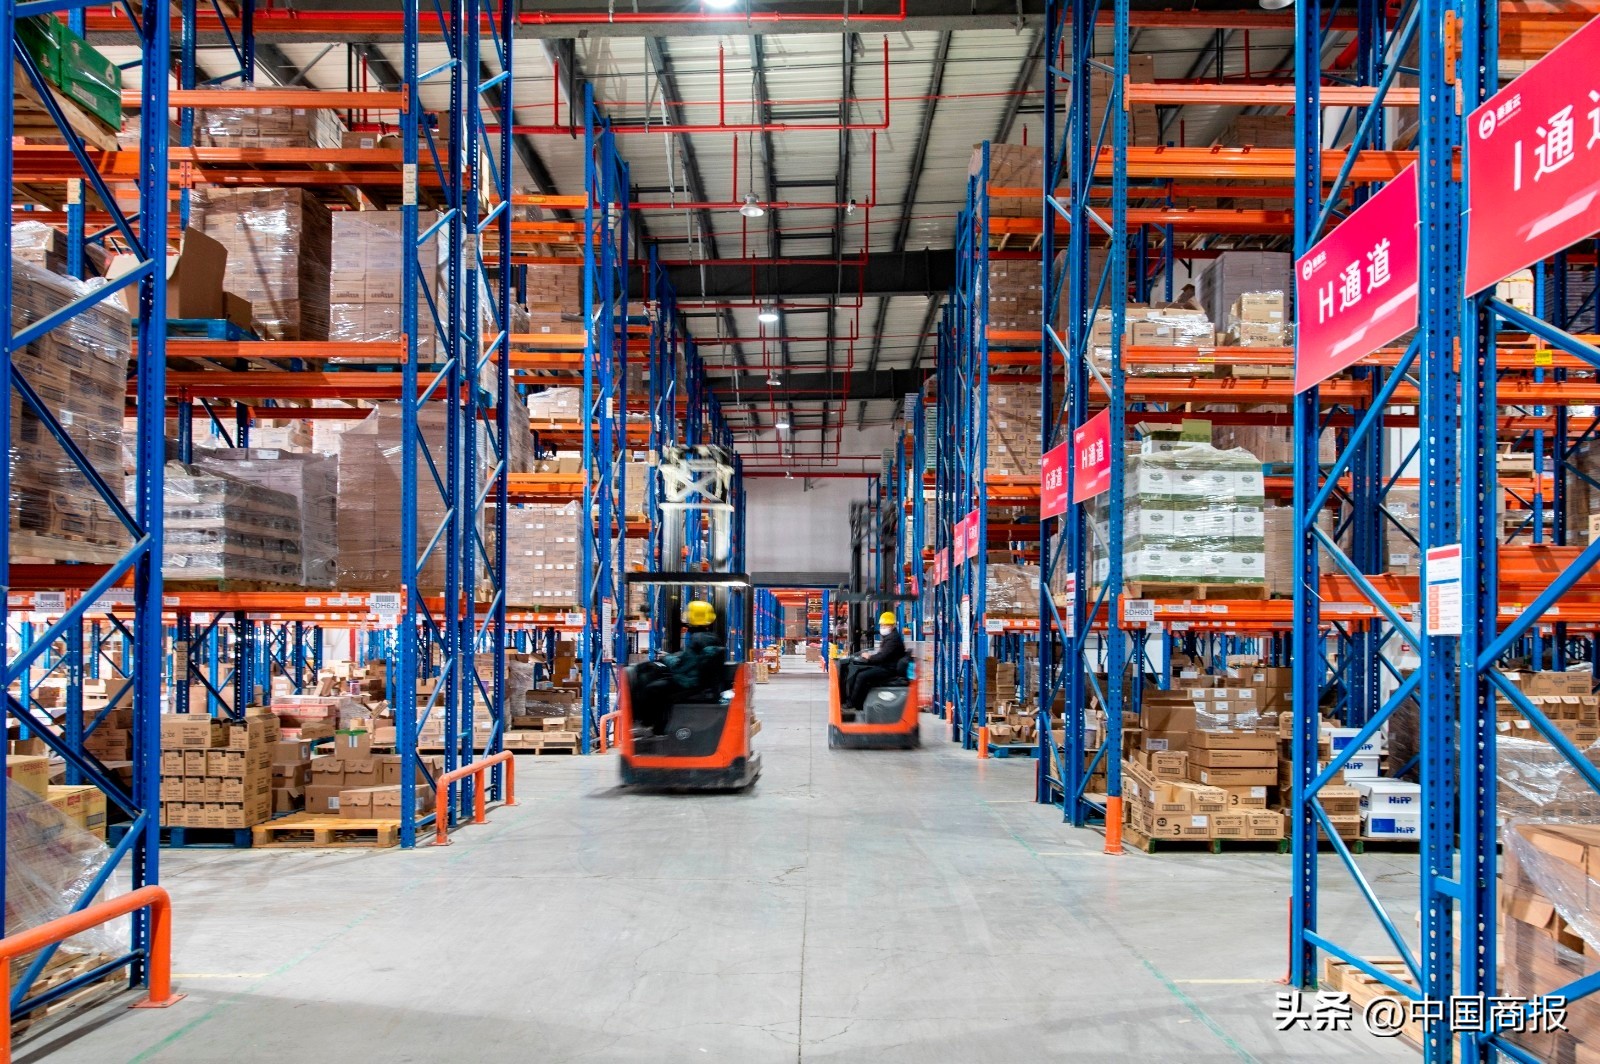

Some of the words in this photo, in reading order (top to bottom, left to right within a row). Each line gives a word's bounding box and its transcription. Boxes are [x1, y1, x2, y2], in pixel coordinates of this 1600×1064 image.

[1318, 237, 1391, 324] H通道
[1081, 438, 1105, 470] H通道
[1343, 762, 1364, 770] HiPP
[1231, 794, 1239, 805] 3
[1388, 796, 1412, 804] HiPP
[1173, 824, 1181, 835] 3
